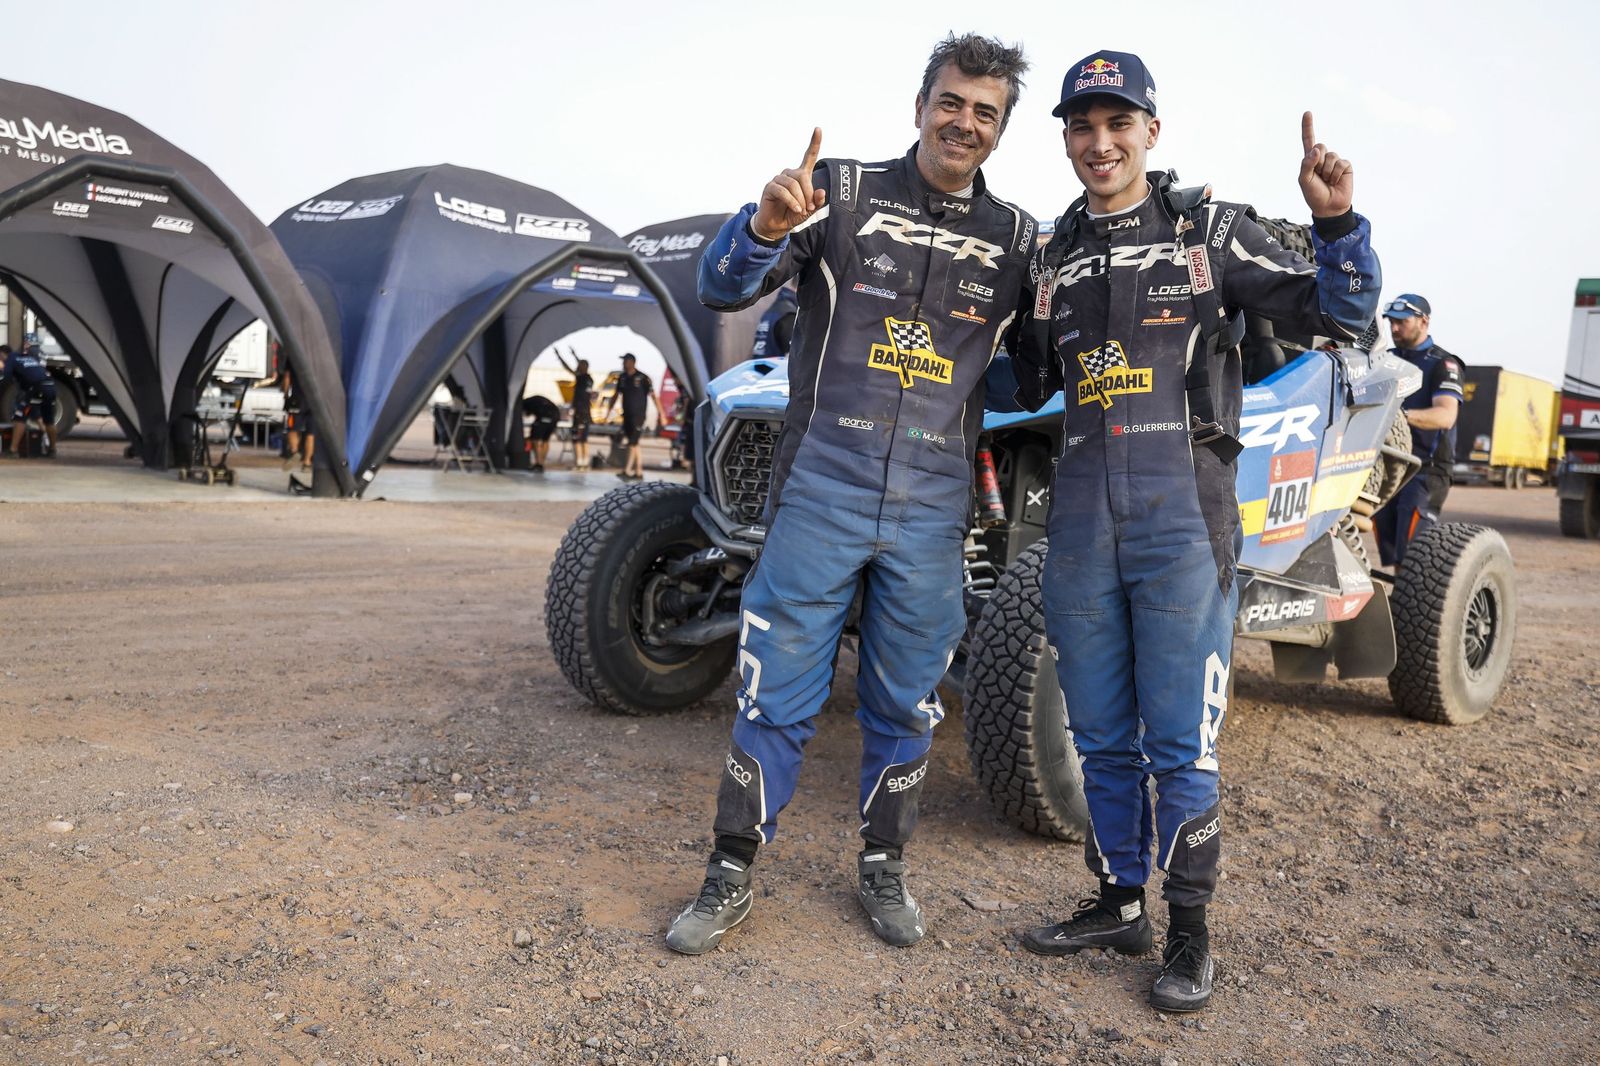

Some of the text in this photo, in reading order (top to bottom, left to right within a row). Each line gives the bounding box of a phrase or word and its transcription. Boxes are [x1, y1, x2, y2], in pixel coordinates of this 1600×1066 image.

[1074, 74, 1125, 93] Red Bull
[0, 117, 133, 155] ayMédia
[839, 164, 851, 201] sparco
[52, 201, 90, 213] LOEB
[434, 191, 507, 224] LOEB
[869, 197, 921, 216] POLARIS
[942, 201, 970, 215] LFM
[1018, 219, 1034, 255] sparco
[1107, 216, 1141, 231] LFM
[1211, 208, 1237, 250] sparco
[856, 211, 1006, 270] RZR
[1063, 246, 1086, 261] LARIS
[1190, 250, 1209, 289] SIMPSON
[958, 279, 995, 297] LOEB
[1037, 281, 1051, 316] SIMPSO
[1147, 284, 1191, 295] LOEB
[872, 349, 948, 382] BARDAHL
[1078, 372, 1149, 402] BARDAHL
[838, 416, 874, 431] sparco
[1123, 422, 1184, 434] G.GUERREIRO
[1237, 403, 1321, 454] ZR
[1268, 481, 1308, 525] 404
[1246, 599, 1317, 623] POLARIS
[887, 760, 928, 793] sparc
[1185, 812, 1221, 849] spar
